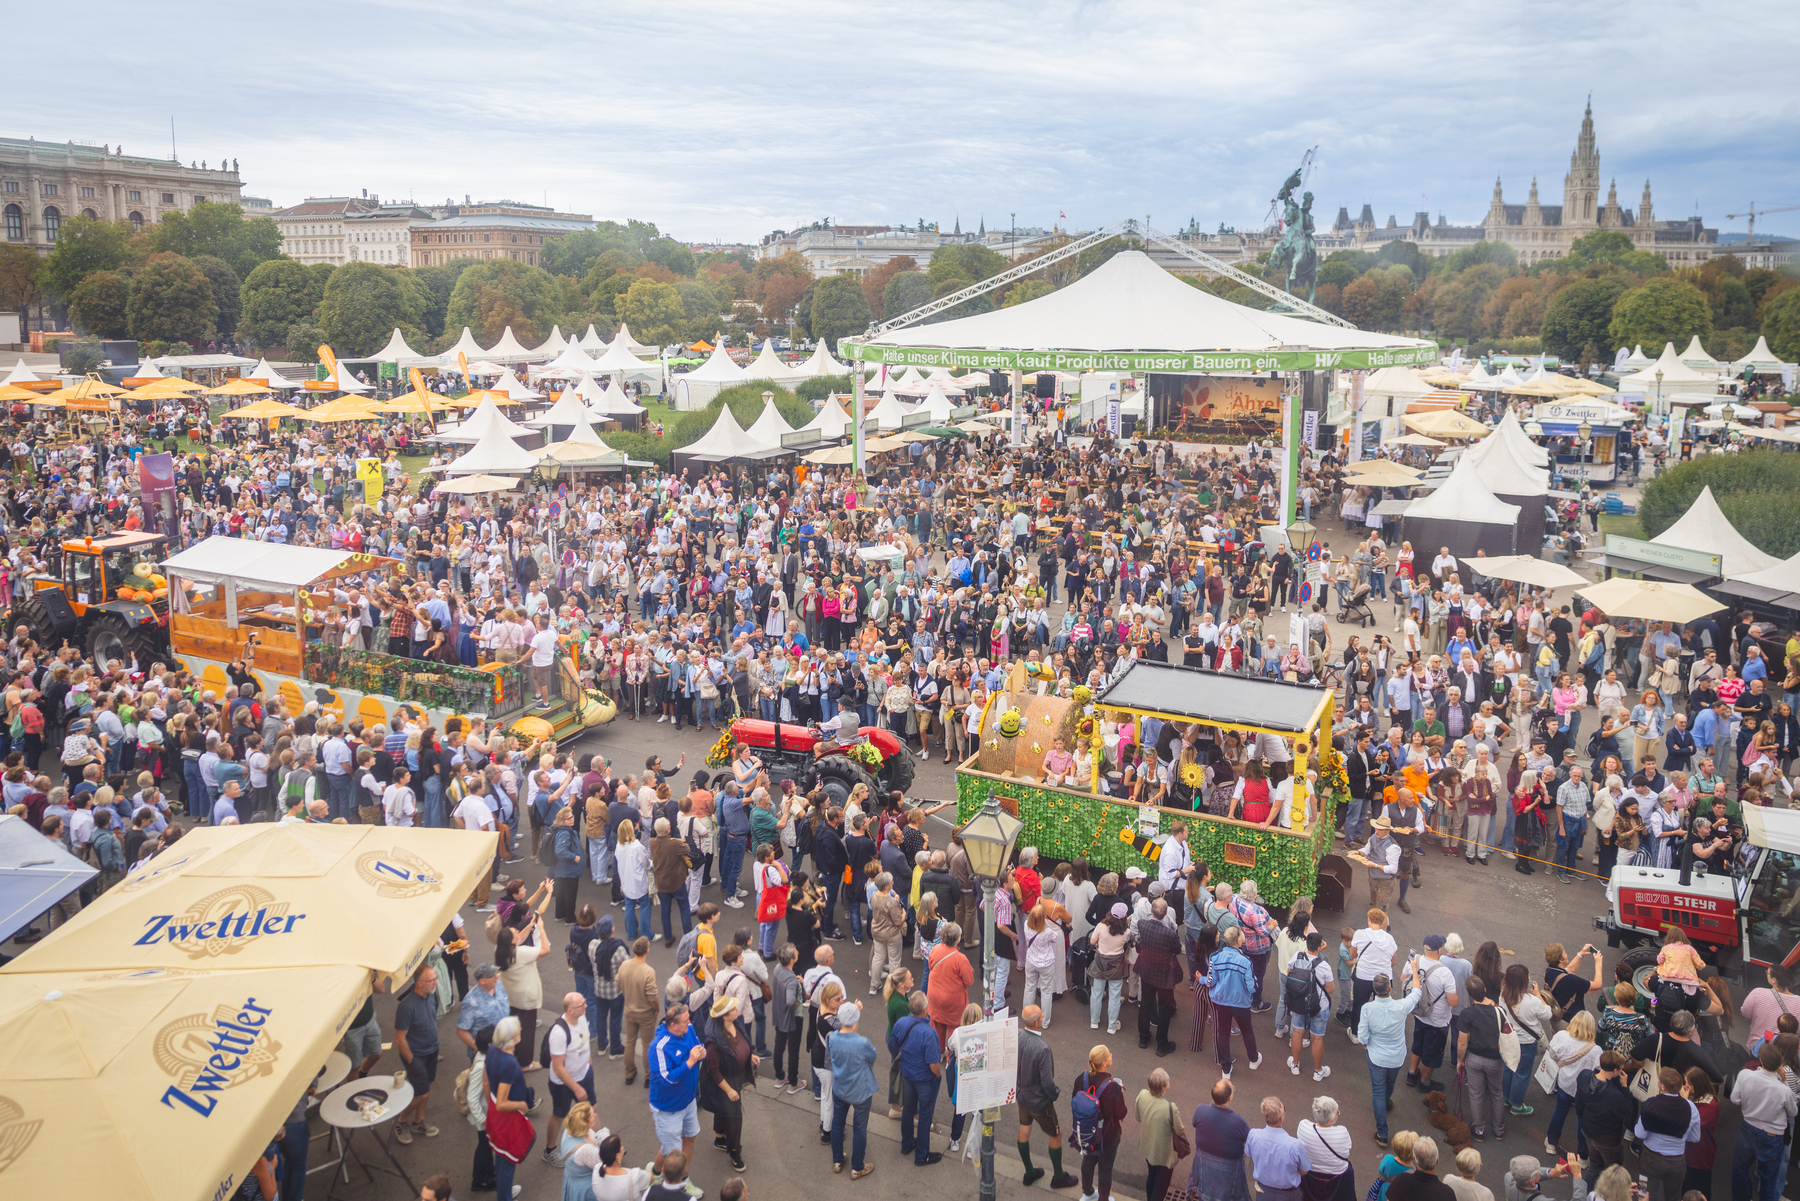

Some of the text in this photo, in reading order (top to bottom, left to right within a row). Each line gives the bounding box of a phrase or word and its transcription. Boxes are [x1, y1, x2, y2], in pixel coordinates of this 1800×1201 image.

[882, 348, 1281, 369] Halte unser Klima rein, kauf Produkte unsrer Bauern ein.
[1368, 352, 1393, 366] Halte
[1394, 353, 1415, 364] unser
[1232, 391, 1280, 411] Ähre!
[1109, 403, 1117, 435] Zwettler
[1565, 408, 1598, 418] Zwettler
[1303, 413, 1314, 447] Zwettler
[1639, 547, 1684, 562] WIENER GUSTO
[1635, 892, 1717, 911] 8070 STEYR
[132, 907, 306, 946] Zwettler
[404, 947, 424, 978] Zwettler
[160, 996, 273, 1118] Zwettler
